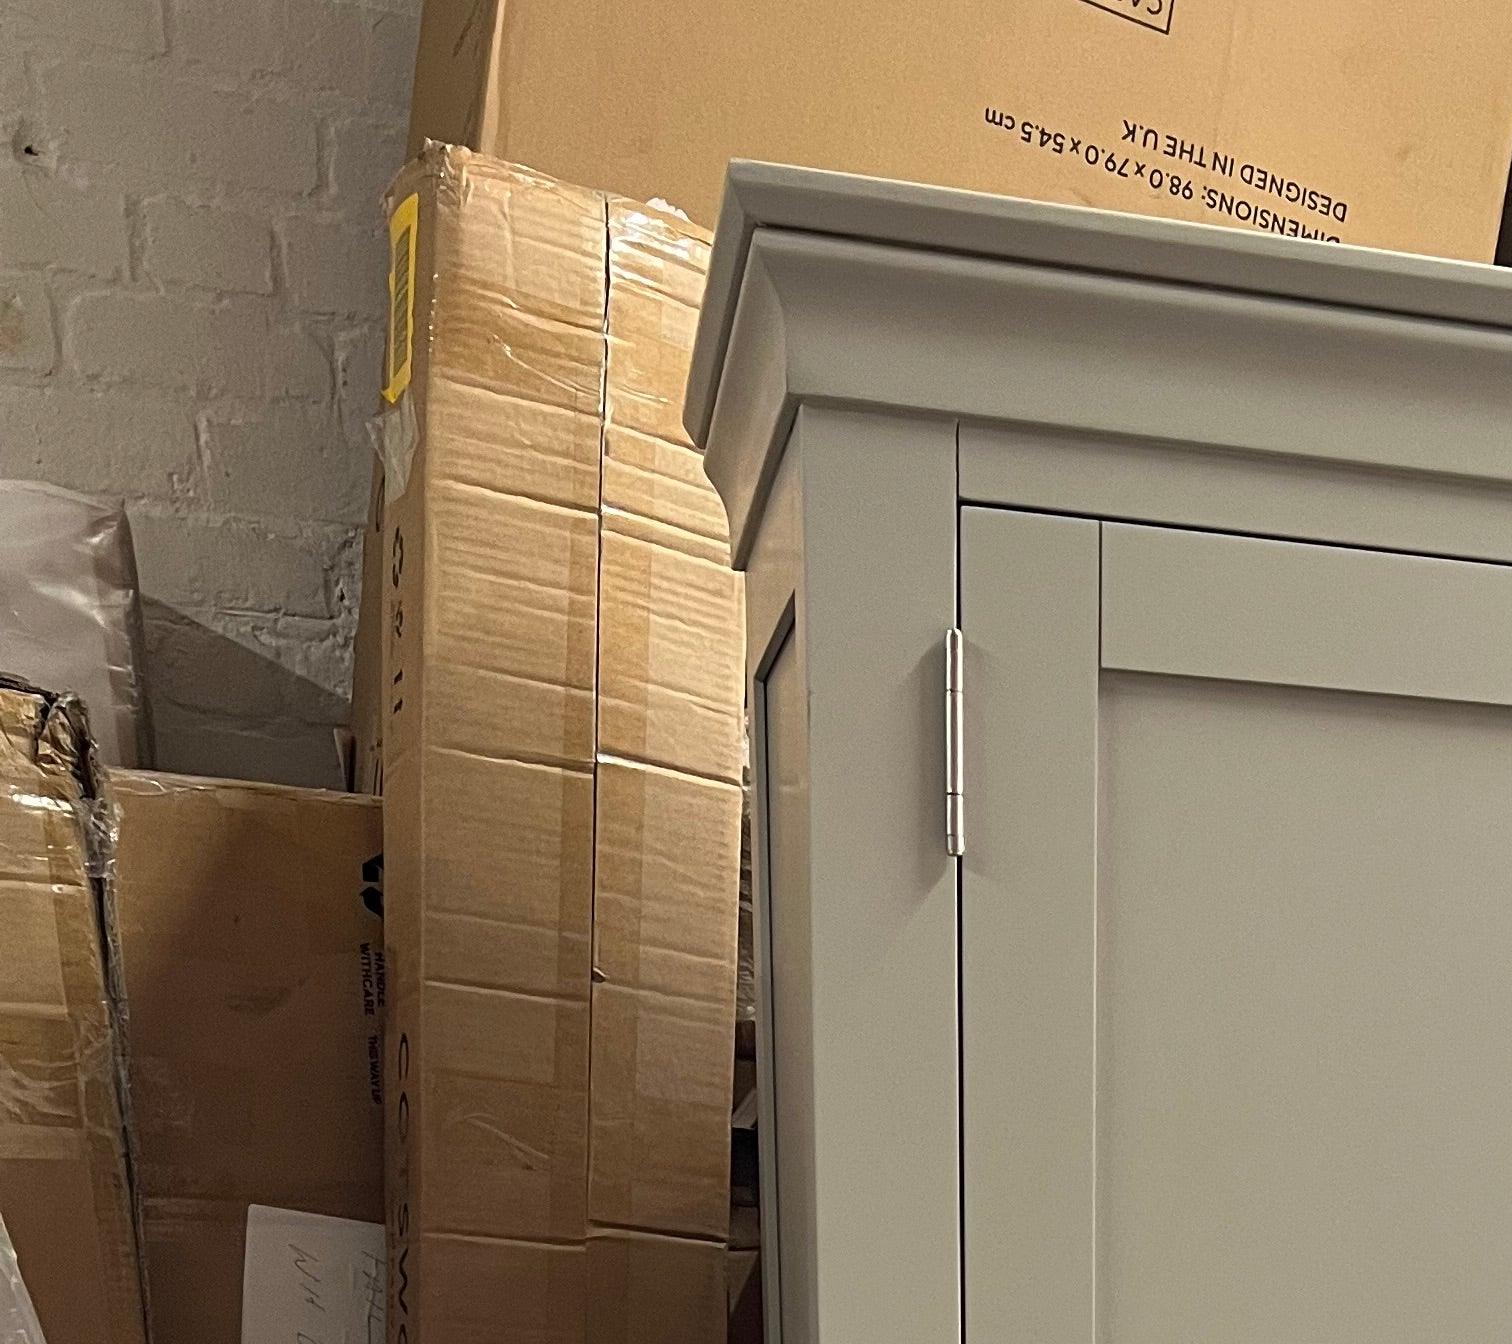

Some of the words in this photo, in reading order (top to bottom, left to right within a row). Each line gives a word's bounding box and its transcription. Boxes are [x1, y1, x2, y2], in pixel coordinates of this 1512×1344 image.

[985, 107, 1016, 131] cm
[1121, 119, 1159, 151] U.K
[1020, 121, 1065, 155] 54.5
[1069, 137, 1082, 155] x
[1163, 134, 1207, 168] THE
[1085, 144, 1130, 179] 79.0
[1134, 162, 1147, 178] x
[1212, 151, 1234, 177] IN
[1149, 168, 1195, 200] 98.0
[1240, 164, 1348, 223] DESIGNED
